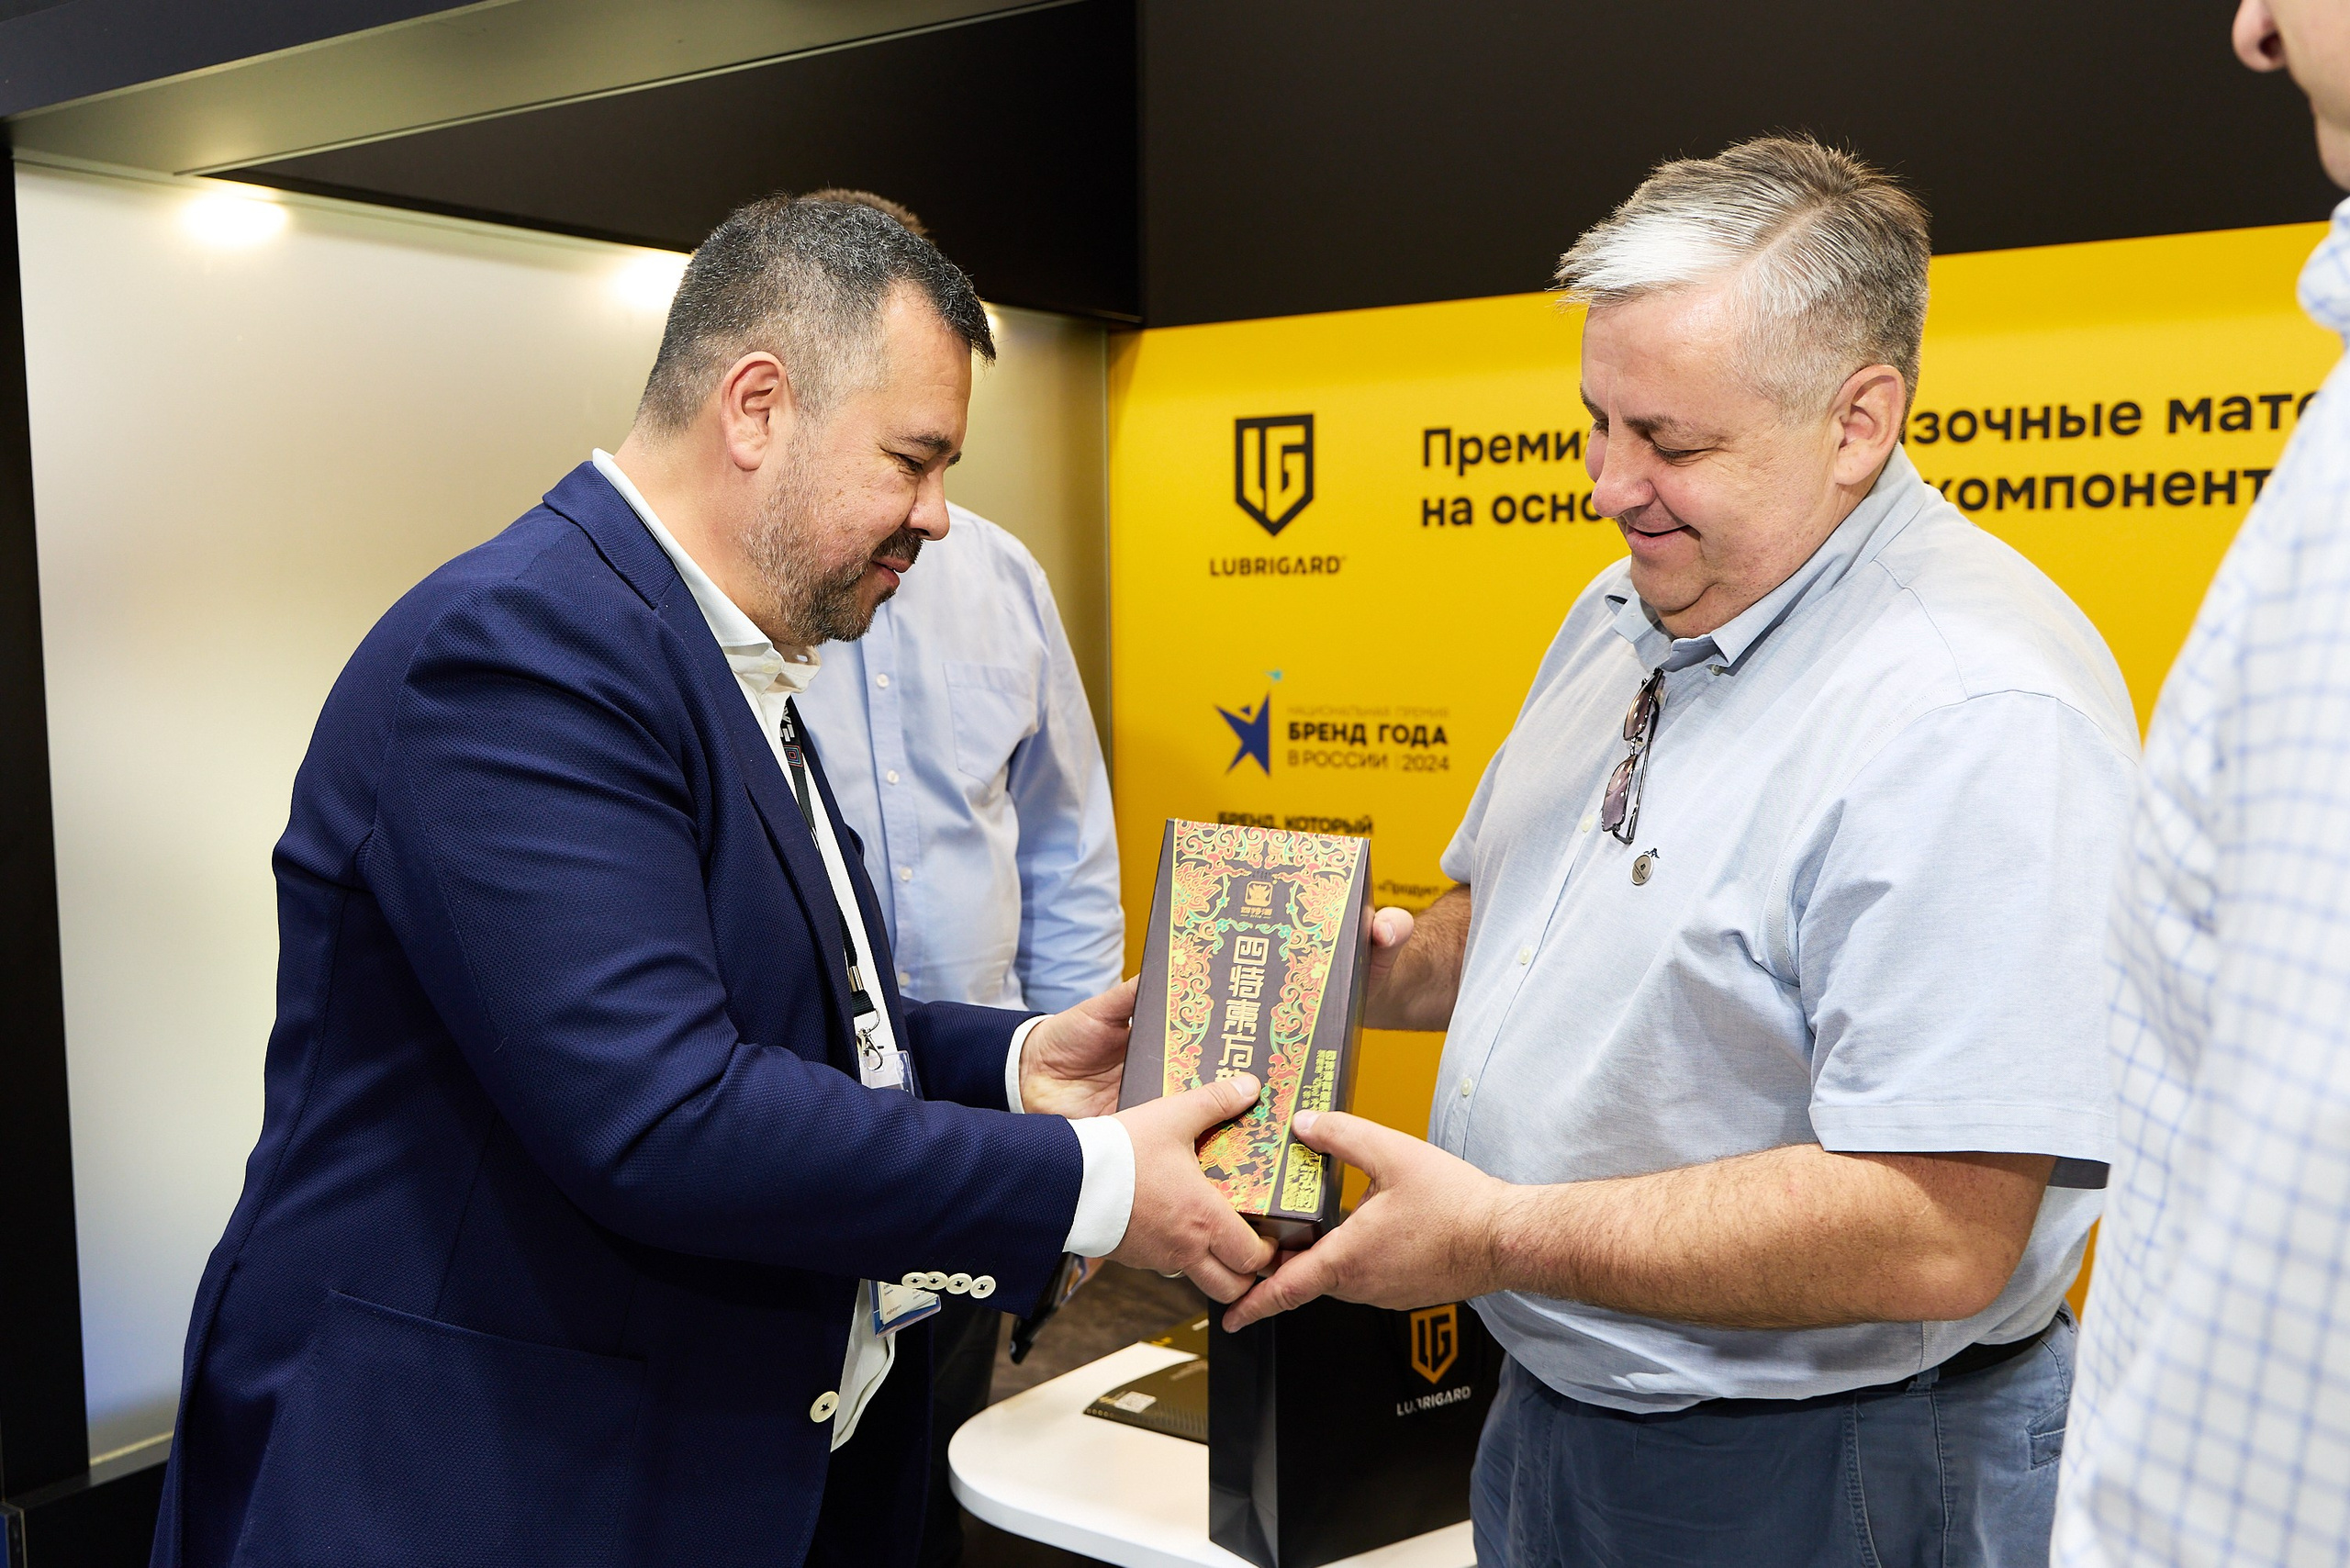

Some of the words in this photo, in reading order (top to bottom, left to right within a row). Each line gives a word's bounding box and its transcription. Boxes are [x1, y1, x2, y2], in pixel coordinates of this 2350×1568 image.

[1423, 428, 1590, 476] Преми
[1900, 400, 2143, 444] зочные
[1423, 497, 1472, 527] на
[1492, 493, 1614, 525] осно
[1210, 555, 1341, 577] LUBRIGARD
[1288, 722, 1367, 745] БРЕНД
[1379, 723, 1448, 747] ГОДА
[1287, 750, 1299, 766] В
[1303, 750, 1388, 768] РОССИИ
[1403, 754, 1449, 772] 2024
